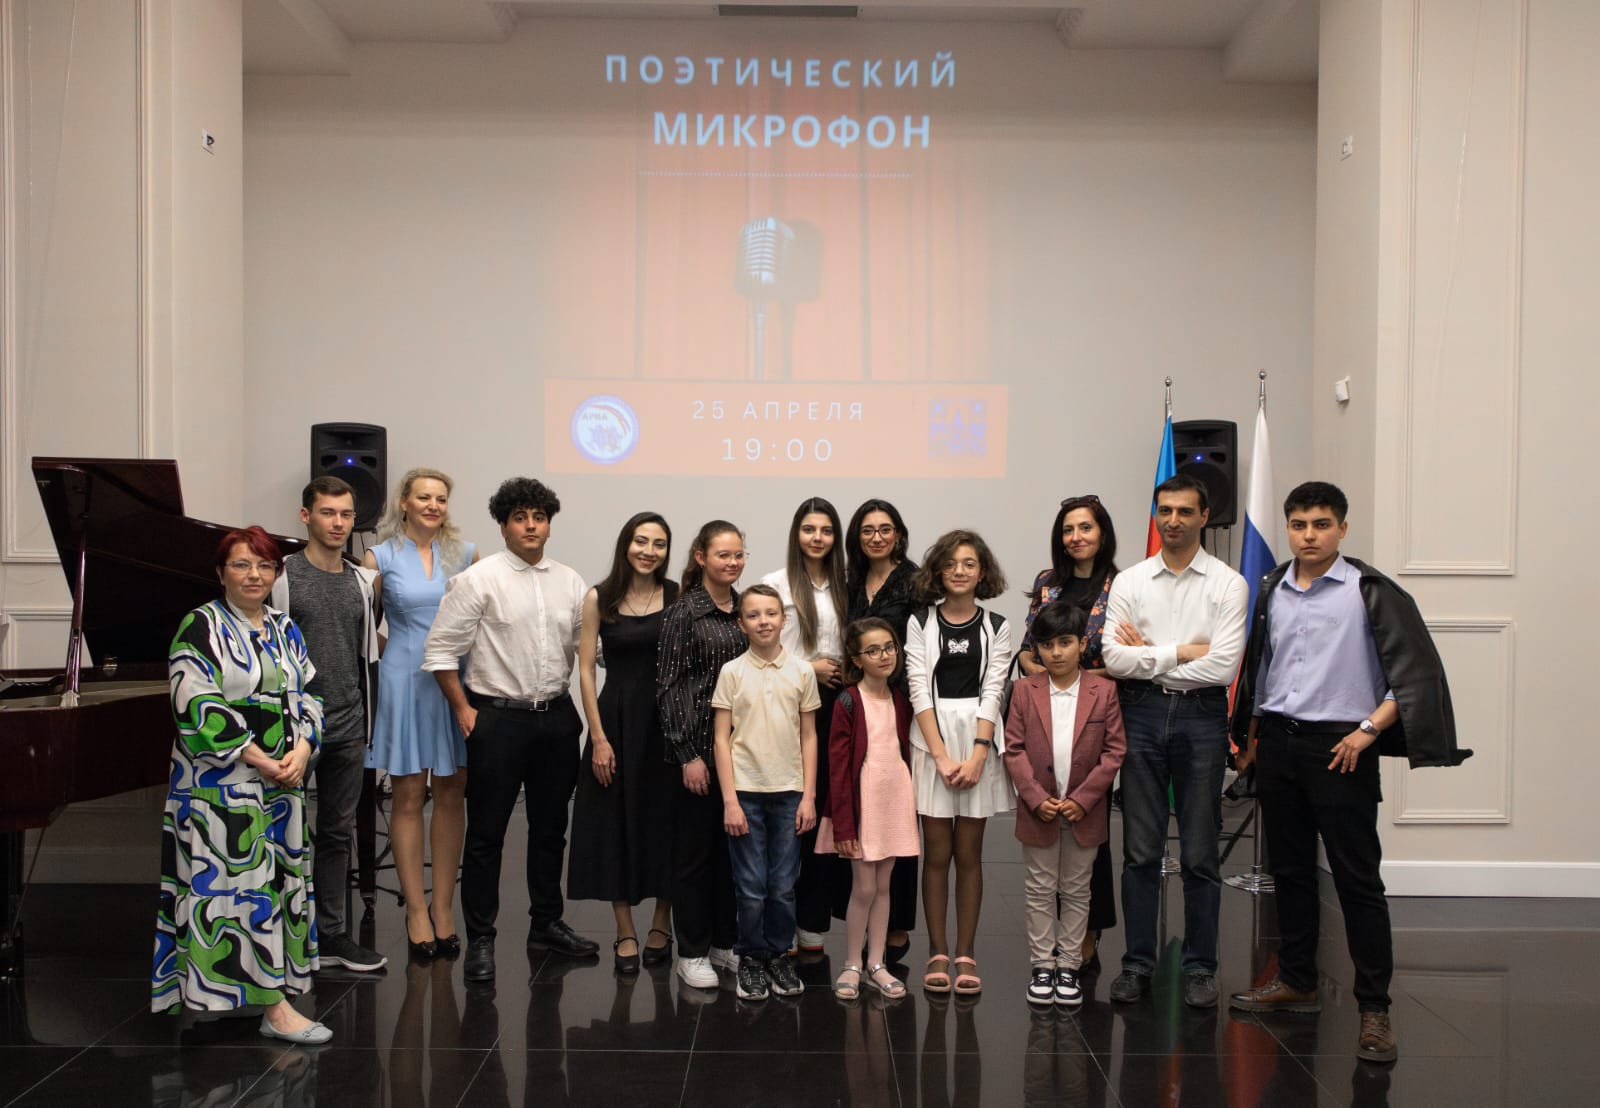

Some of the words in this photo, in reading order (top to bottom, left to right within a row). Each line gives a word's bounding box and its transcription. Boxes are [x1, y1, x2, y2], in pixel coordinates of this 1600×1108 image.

[605, 51, 956, 88] ПОЭТИЧЕСКИЙ
[653, 111, 932, 149] МИКРОФОН
[691, 400, 726, 421] 25
[742, 400, 865, 421] АПРЕЛЯ
[721, 437, 834, 463] 19:00
